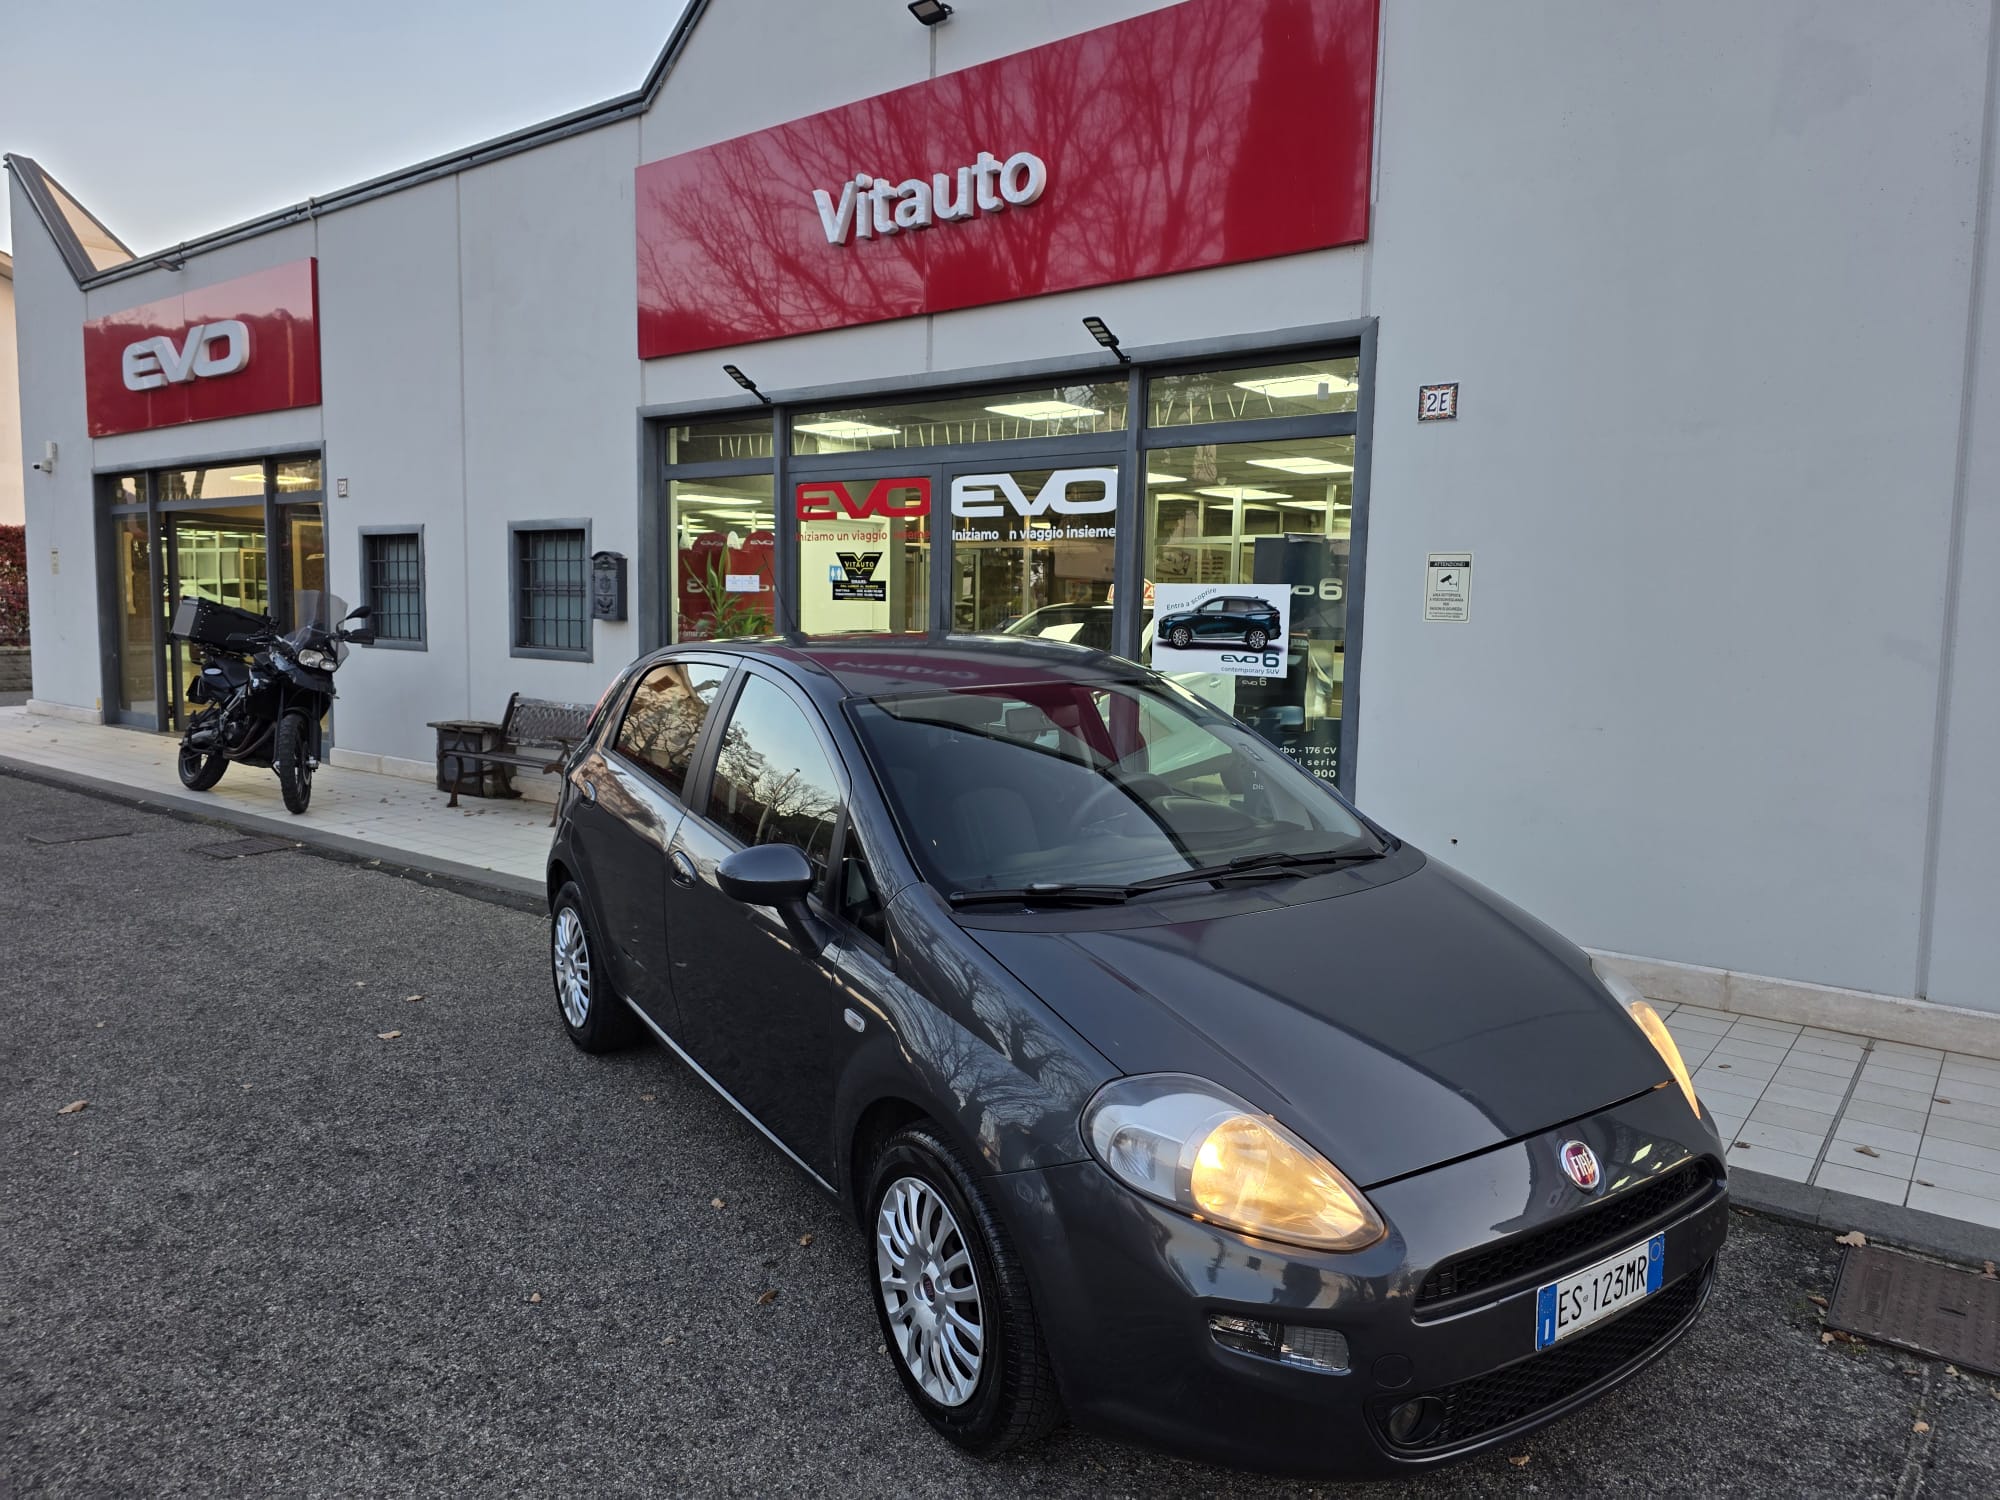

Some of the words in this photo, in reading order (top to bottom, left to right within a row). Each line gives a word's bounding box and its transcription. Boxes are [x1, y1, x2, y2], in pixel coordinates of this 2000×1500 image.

[812, 150, 1048, 246] Vitauto
[121, 318, 250, 392] EVO
[1426, 392, 1449, 412] 2E
[796, 477, 932, 520] EVO
[951, 468, 1118, 517] EVO
[796, 531, 834, 542] niziamo
[836, 531, 849, 541] un
[851, 528, 888, 544] viaggio
[951, 528, 999, 541] Iniziamo
[1020, 526, 1064, 541] viaggio
[1066, 524, 1116, 539] insieme
[1319, 577, 1343, 601] 6
[1166, 600, 1185, 612] Entra
[1221, 654, 1259, 664] EVO
[1262, 651, 1280, 668] 6
[1220, 666, 1265, 676] contemporary
[1323, 746, 1337, 754] CV
[1307, 758, 1337, 766] serie
[1570, 1151, 1594, 1178] FIAT
[1557, 1285, 1583, 1329] ES
[1592, 1255, 1647, 1311] 123MR
